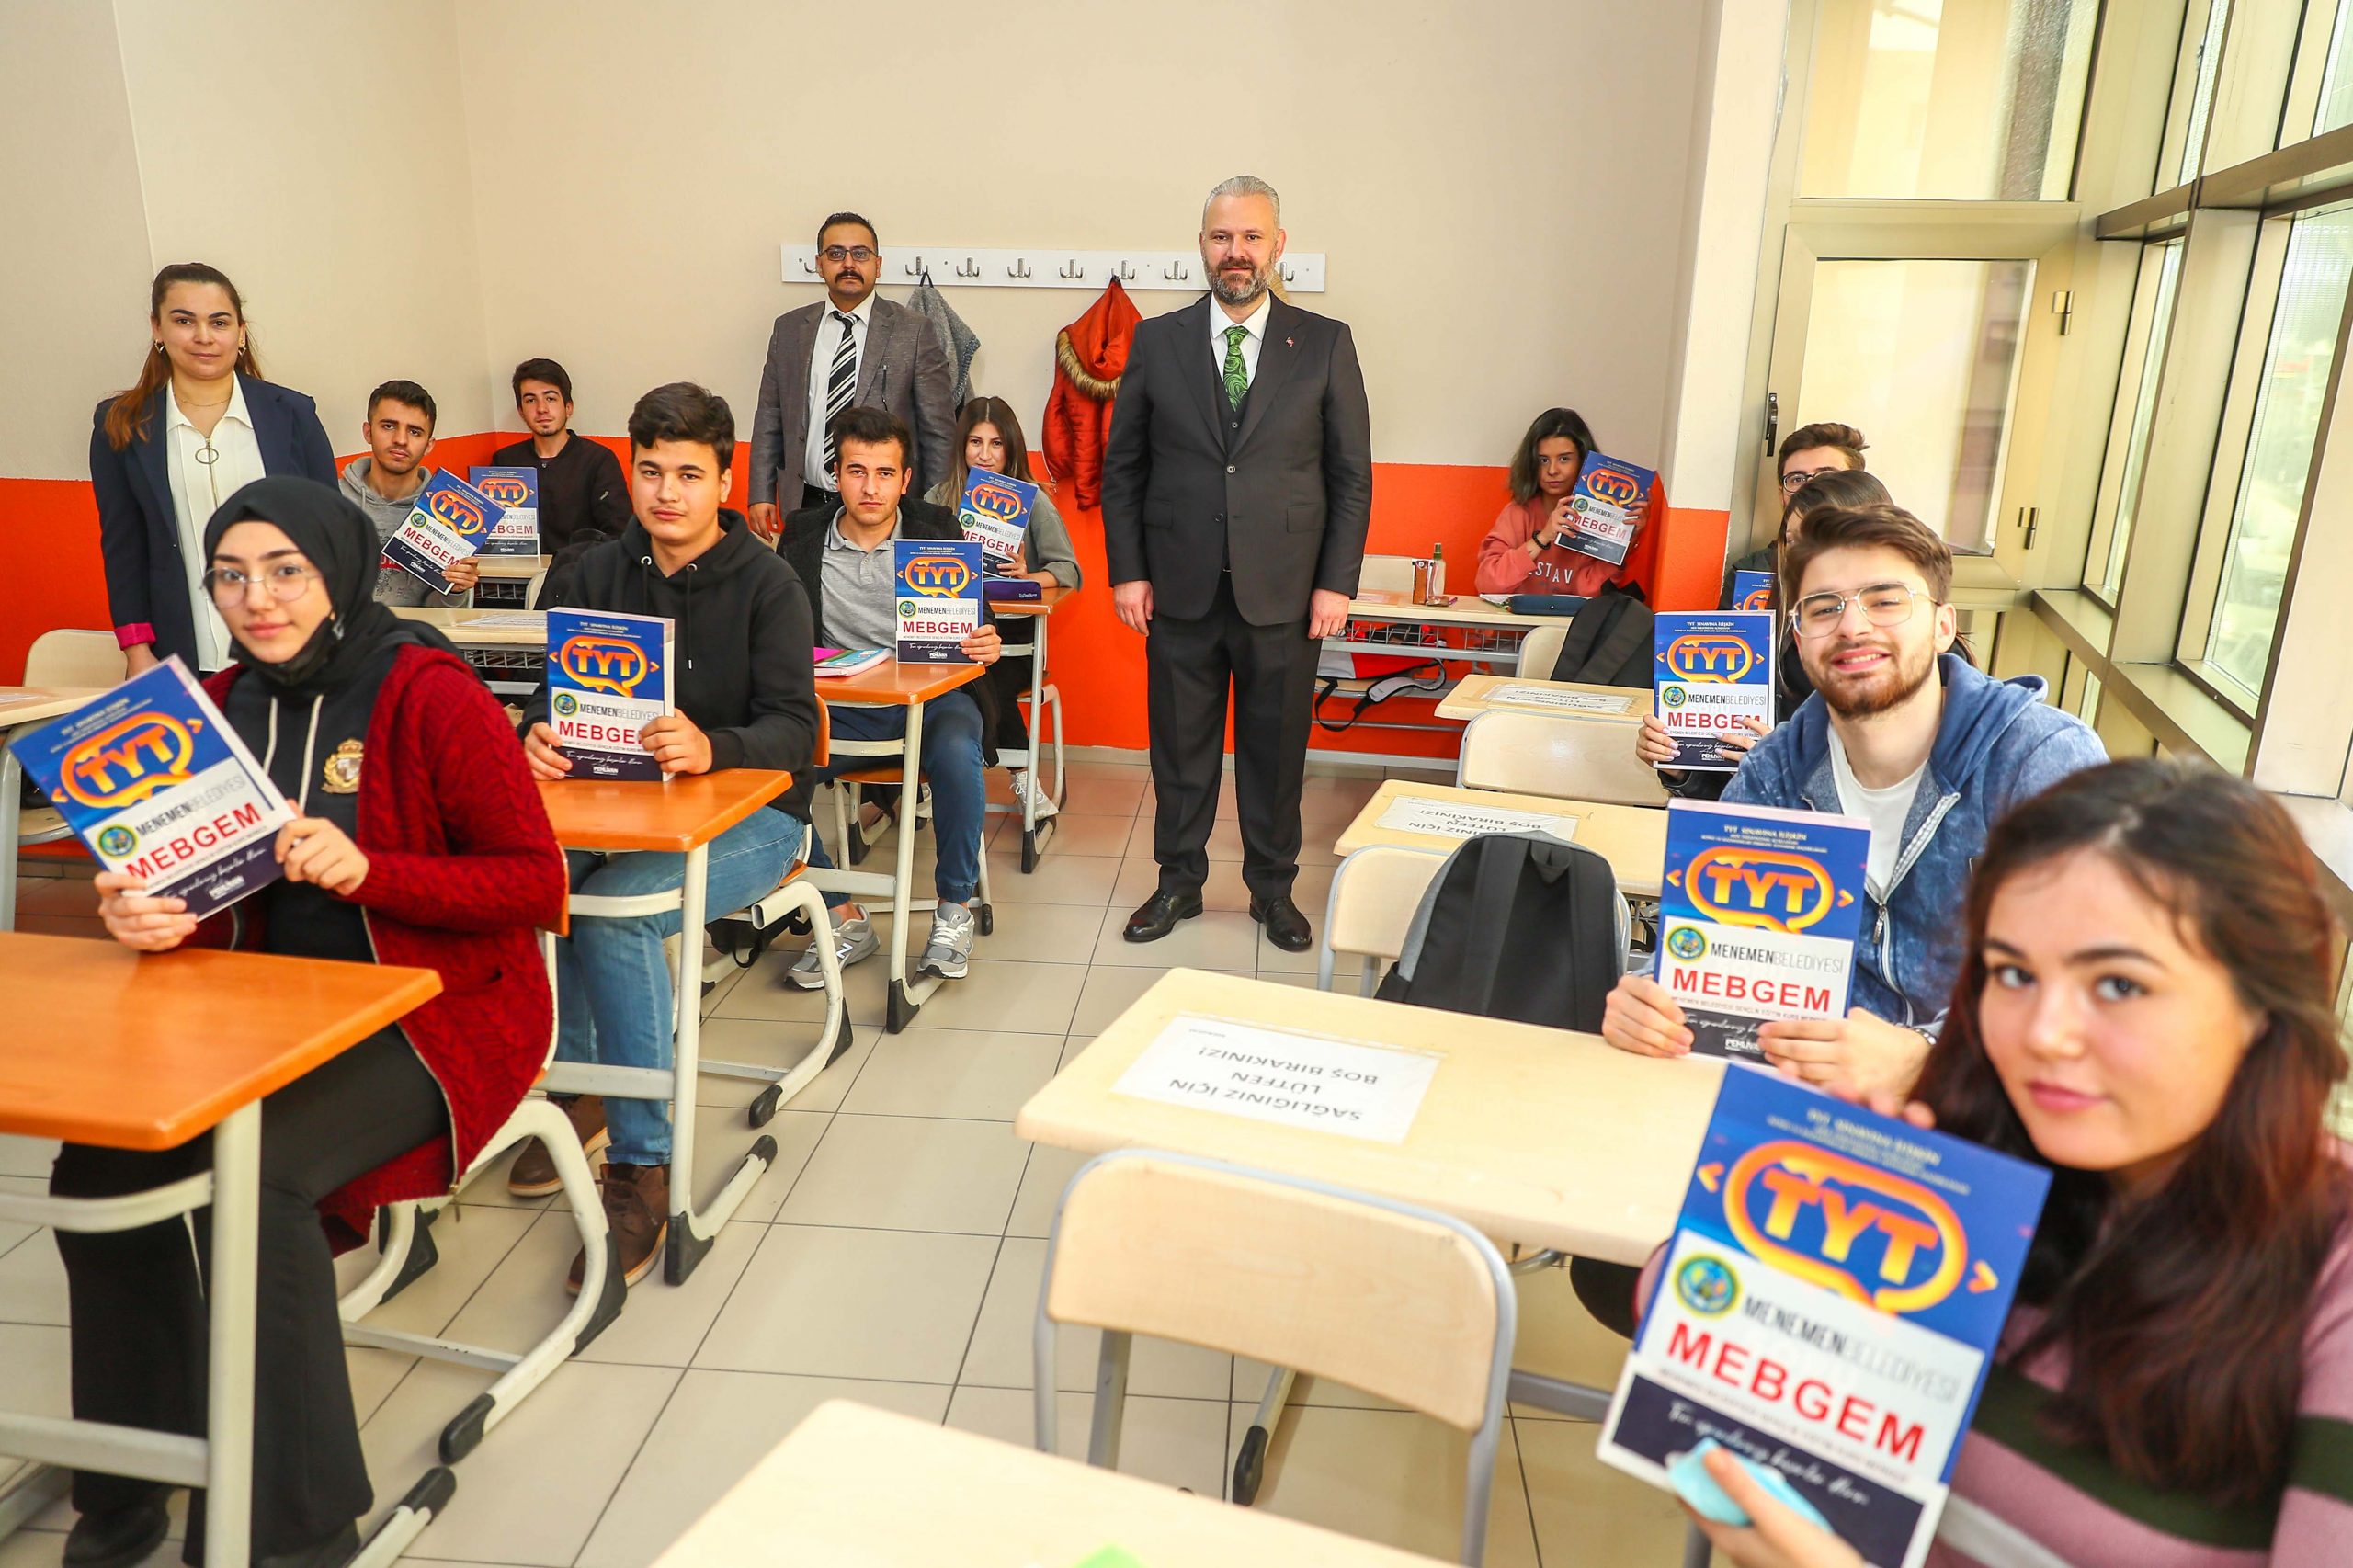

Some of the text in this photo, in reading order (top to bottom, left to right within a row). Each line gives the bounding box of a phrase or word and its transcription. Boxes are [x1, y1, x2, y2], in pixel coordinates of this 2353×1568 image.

[484, 485, 520, 499] TYT
[1596, 475, 1632, 498] TYT
[438, 495, 478, 528] TYT
[980, 491, 1017, 514] TYT
[404, 527, 460, 566] MEBGEM
[915, 567, 961, 585] TYT
[1529, 562, 1573, 584] STAV
[903, 621, 972, 633] MEBGEM
[572, 648, 636, 677] TYT
[1679, 647, 1741, 671] TYT
[559, 721, 642, 744] MEBGE
[76, 724, 174, 794] TYT
[125, 802, 262, 880] MEBGEM
[1706, 864, 1815, 913] TYT
[1673, 968, 1830, 1012] MEBGEM
[1199, 1046, 1379, 1085] BOŞ BIRAKINIZ!
[1232, 1072, 1321, 1095] LÜTFEN
[1169, 1078, 1362, 1121] SAĞLIĞINIZ İÇİN
[1762, 1167, 1939, 1285] TYT
[1666, 1322, 1926, 1464] MEBGEM
